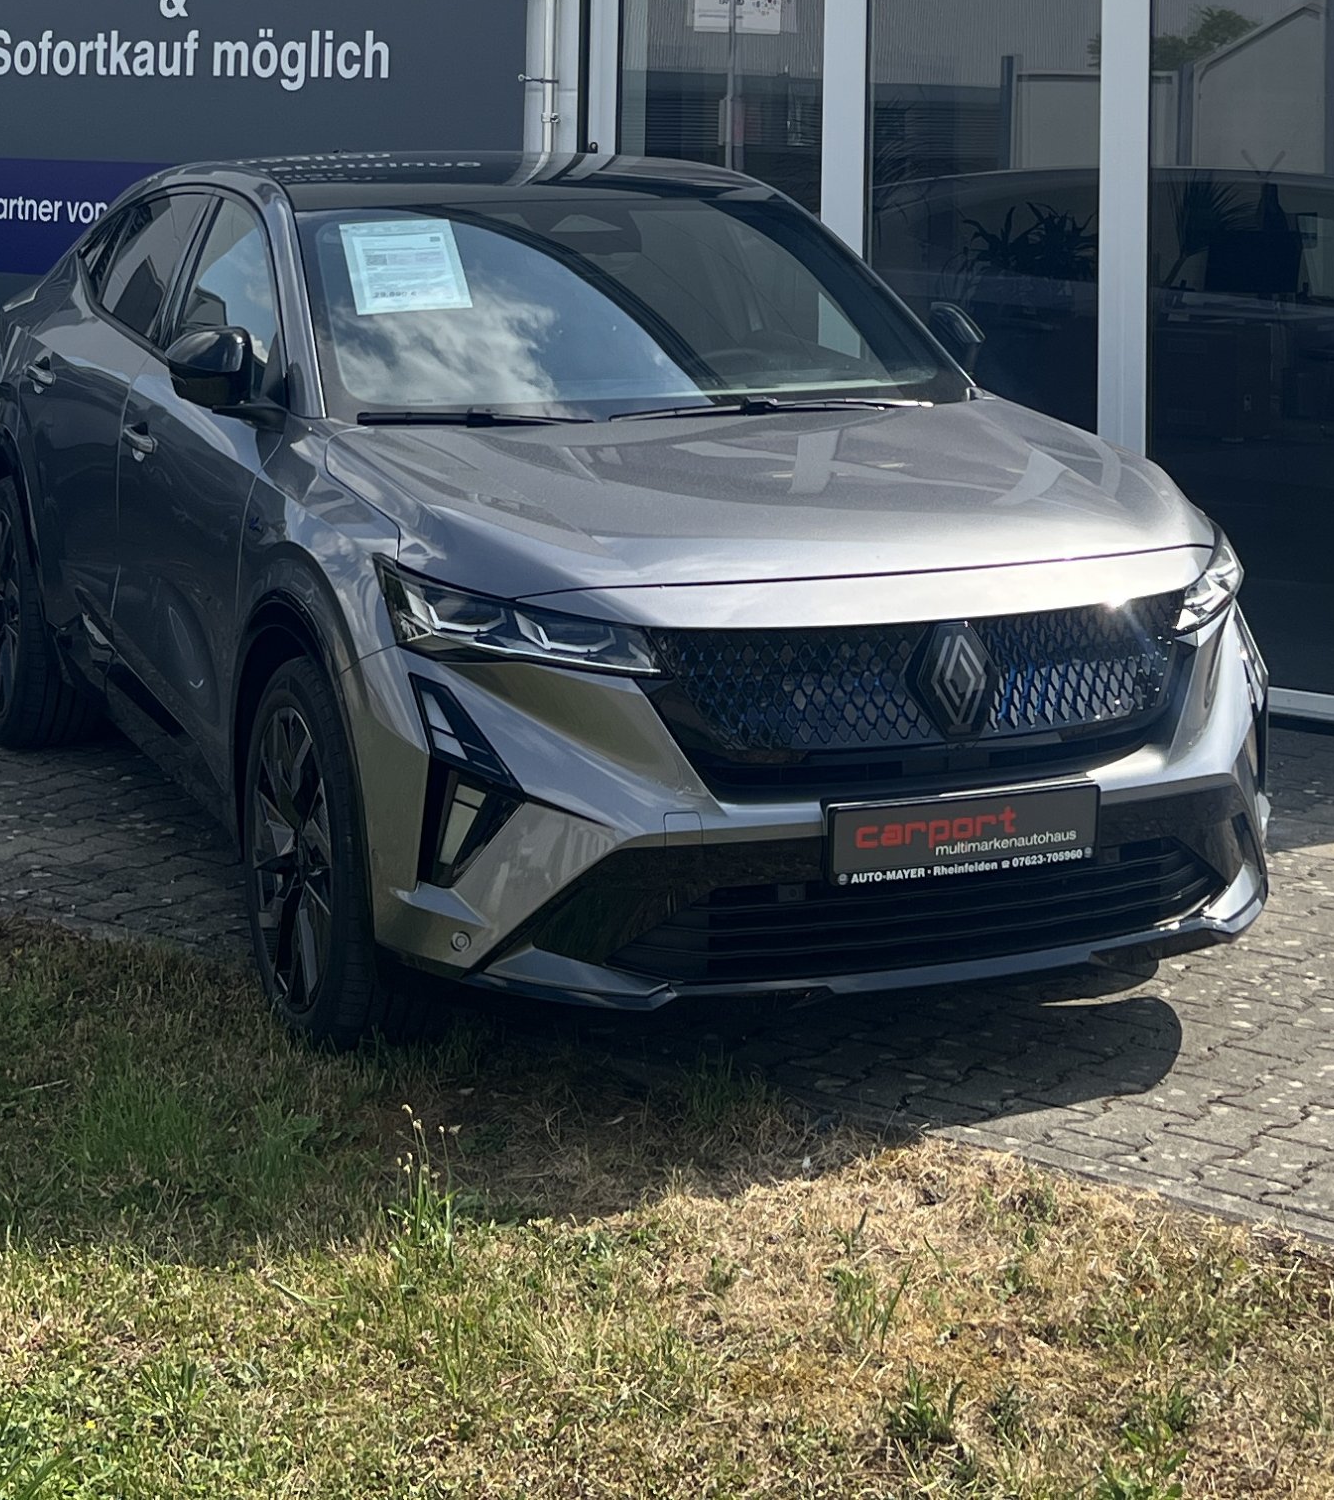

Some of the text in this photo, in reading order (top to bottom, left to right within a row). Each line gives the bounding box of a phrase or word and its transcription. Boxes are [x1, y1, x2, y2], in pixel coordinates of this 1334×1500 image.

[212, 28, 390, 91] möglich
[855, 806, 1017, 850] carport
[935, 829, 1077, 856] multimarkenautohaus
[850, 848, 1083, 884] AUTO-MAYER Rheinfelden 07623-705960
